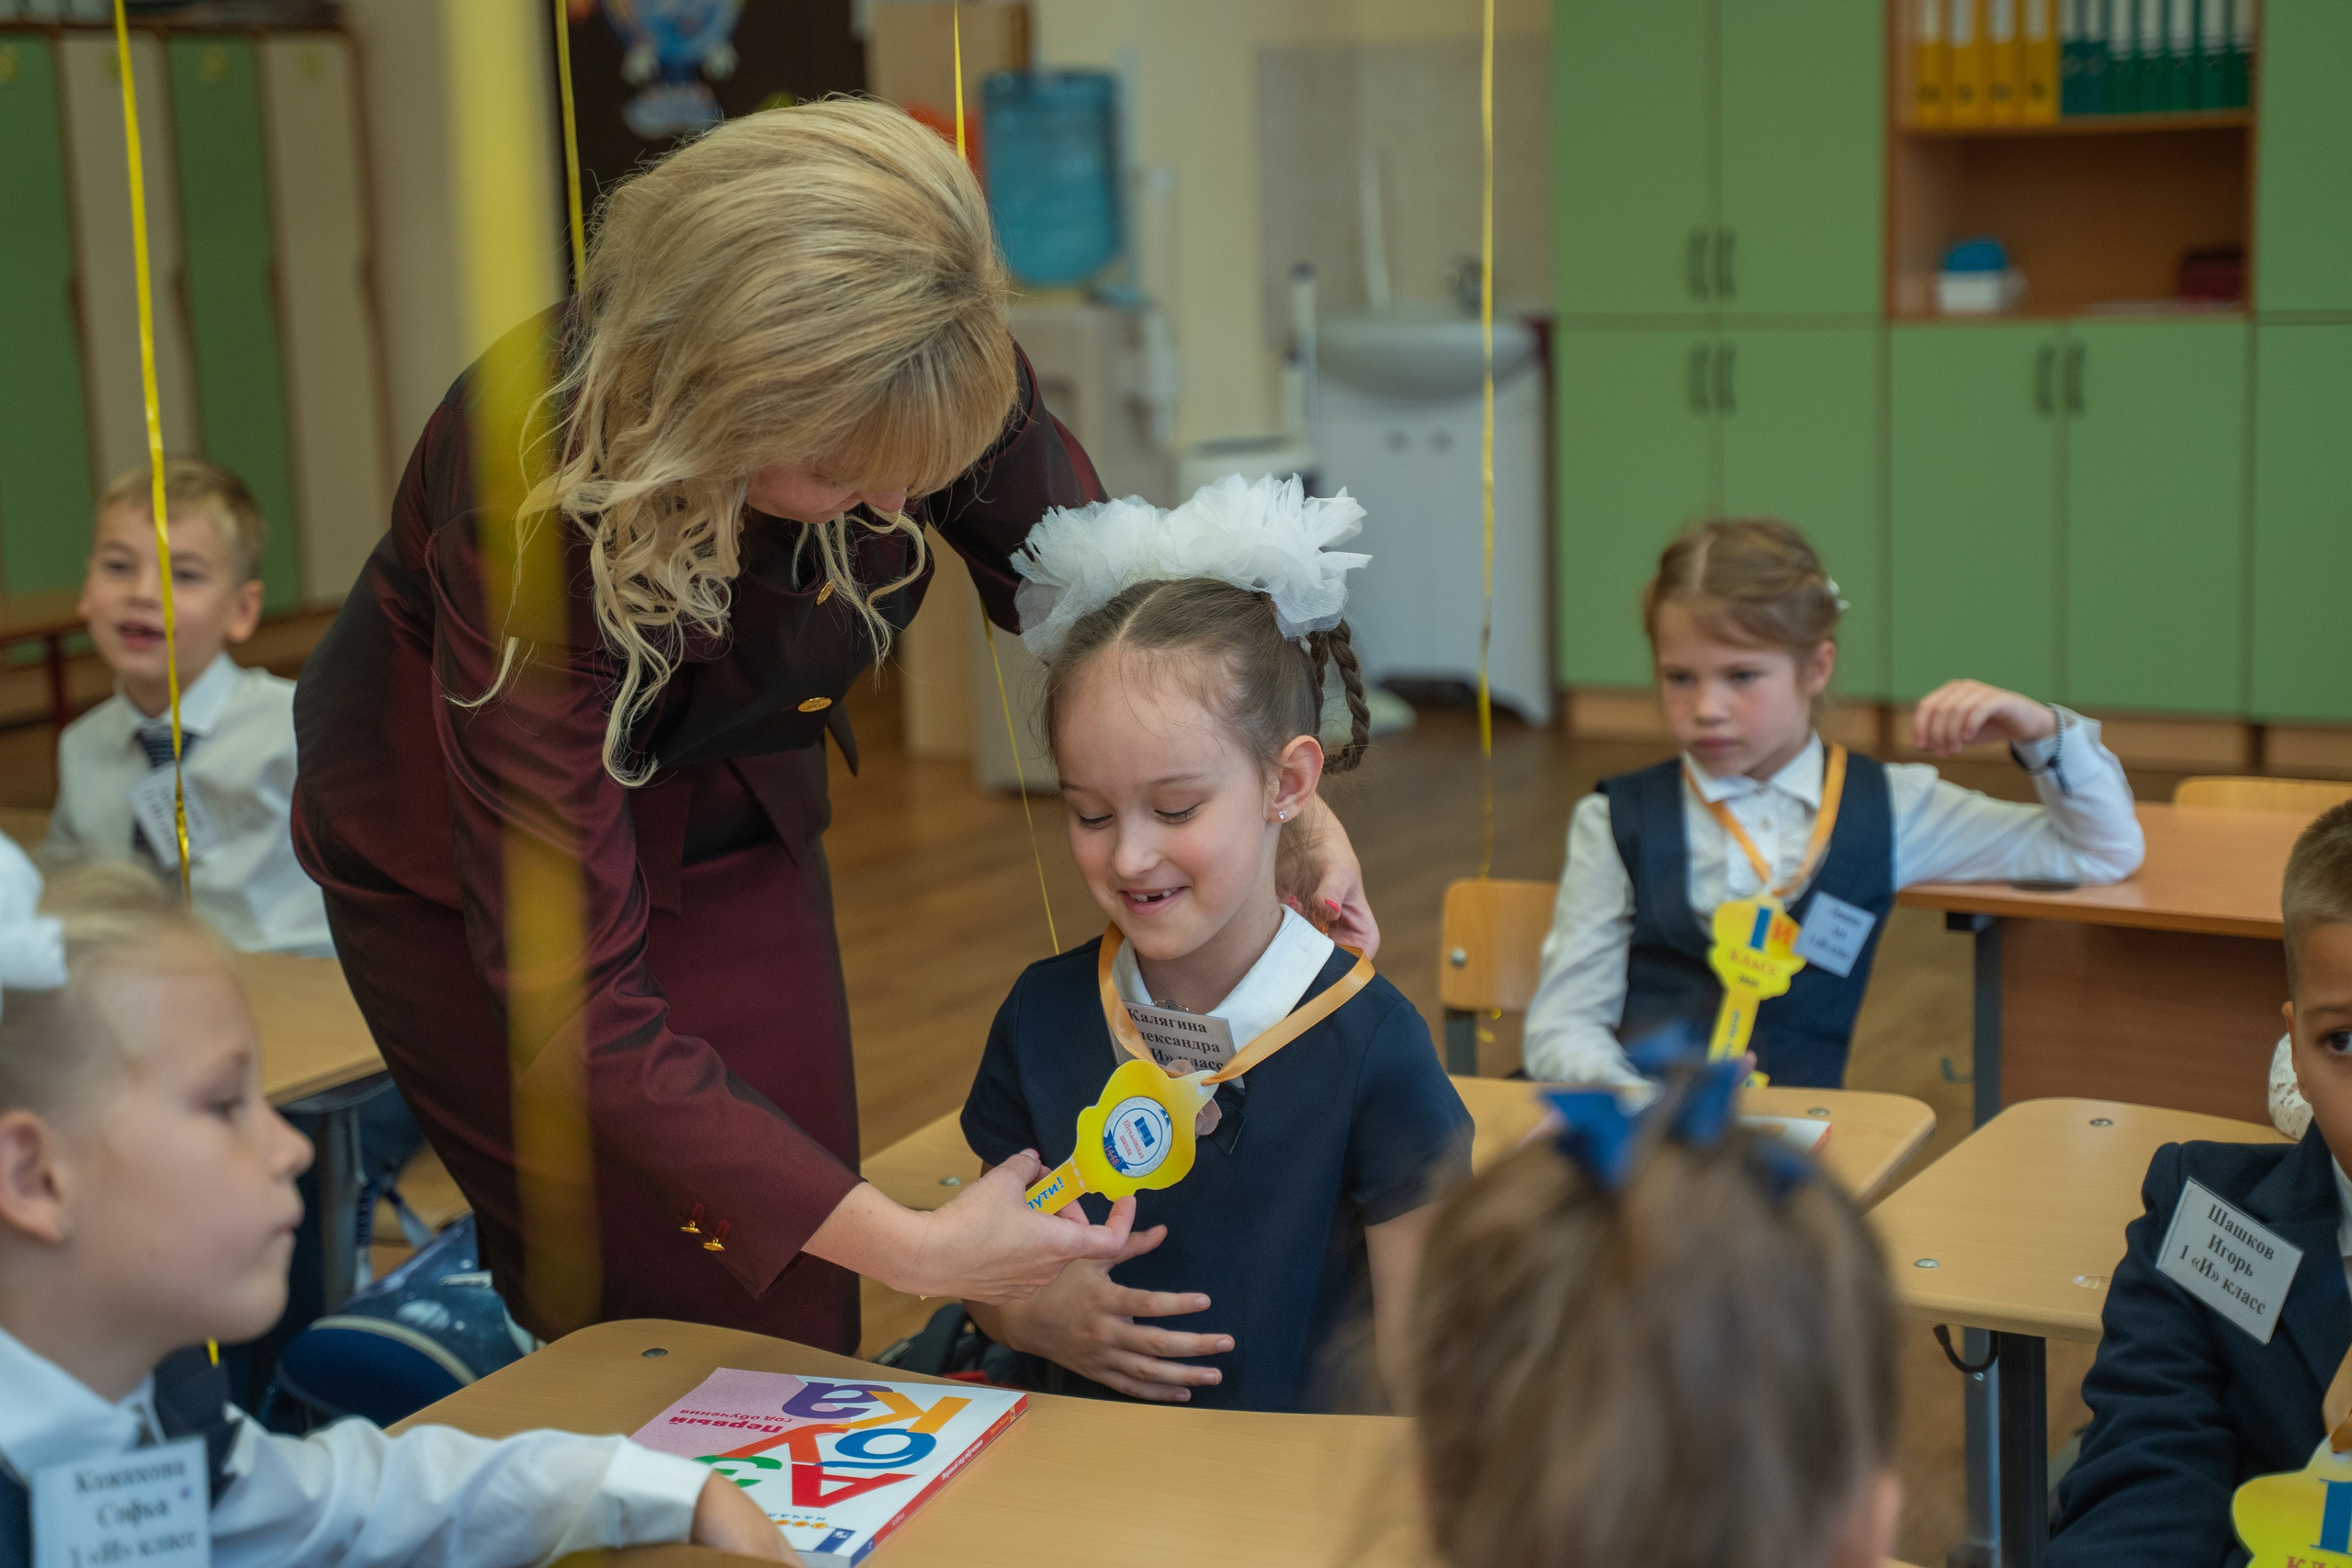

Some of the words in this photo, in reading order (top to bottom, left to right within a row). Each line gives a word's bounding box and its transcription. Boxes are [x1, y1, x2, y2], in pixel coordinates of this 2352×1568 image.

[1127, 1008, 1207, 1033] Калягина
[1138, 1031, 1221, 1054] лександра
[1104, 1145, 1120, 1168] 1448
[2207, 1202, 2276, 1261] Шашков
[2206, 1233, 2255, 1278] Игорь
[2178, 1244, 2189, 1261] 1
[2191, 1256, 2220, 1283] «И»
[2222, 1277, 2267, 1316] класс
[668, 1416, 785, 1435] Первый
[679, 1408, 761, 1423] обучения
[763, 1414, 794, 1424] год
